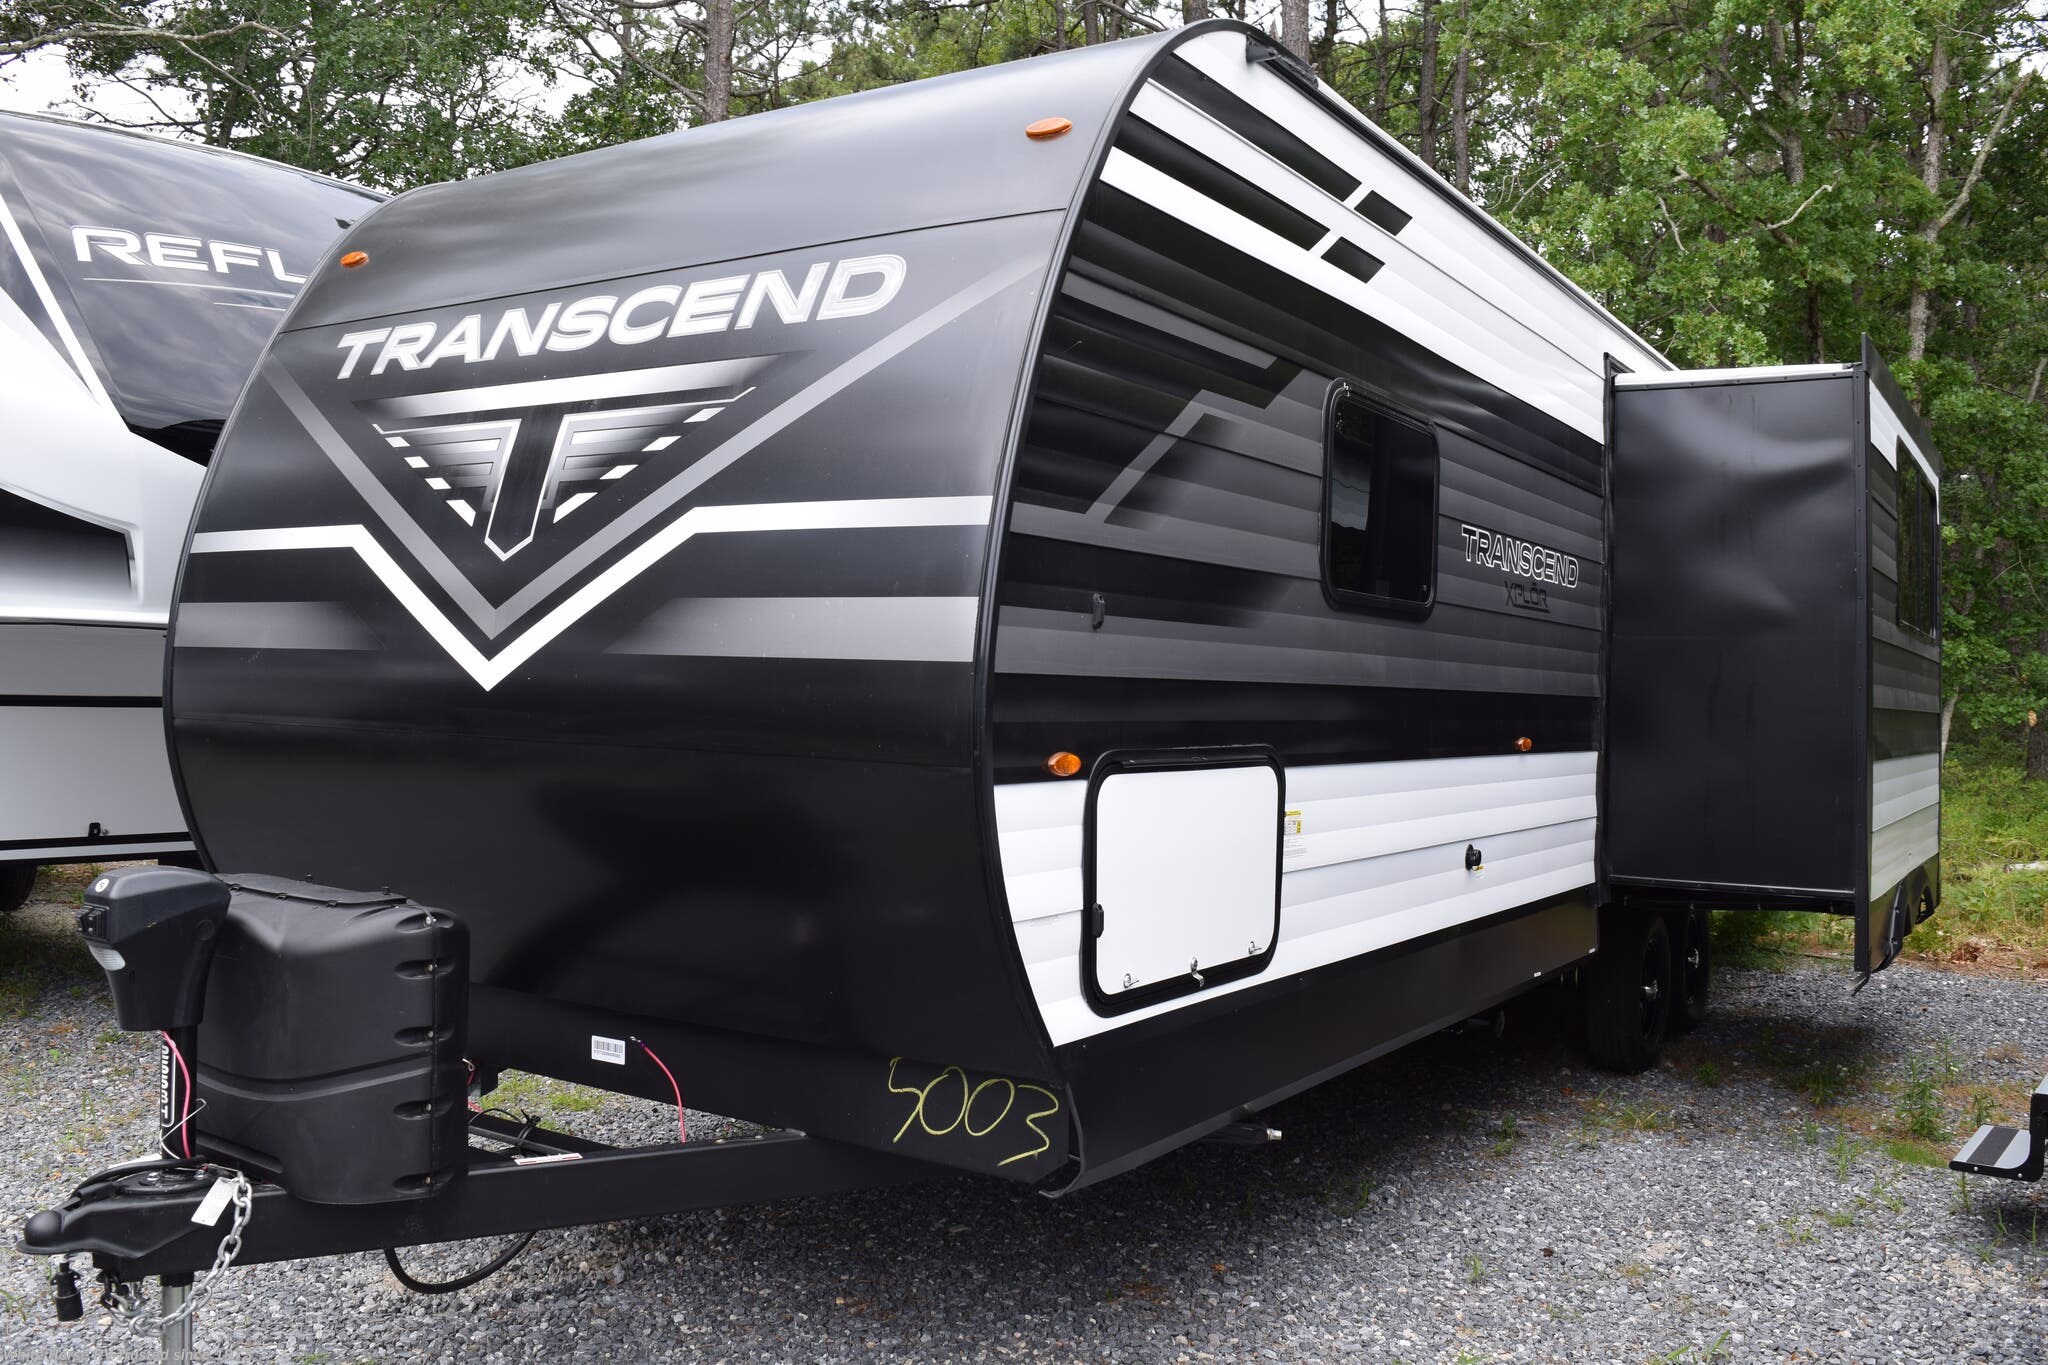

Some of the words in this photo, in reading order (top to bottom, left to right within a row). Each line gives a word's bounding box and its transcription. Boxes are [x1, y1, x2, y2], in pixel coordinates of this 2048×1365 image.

[336, 253, 907, 380] TRANSCEND
[1461, 523, 1579, 589] TRANSCEND
[889, 1056, 1059, 1167] 5003
